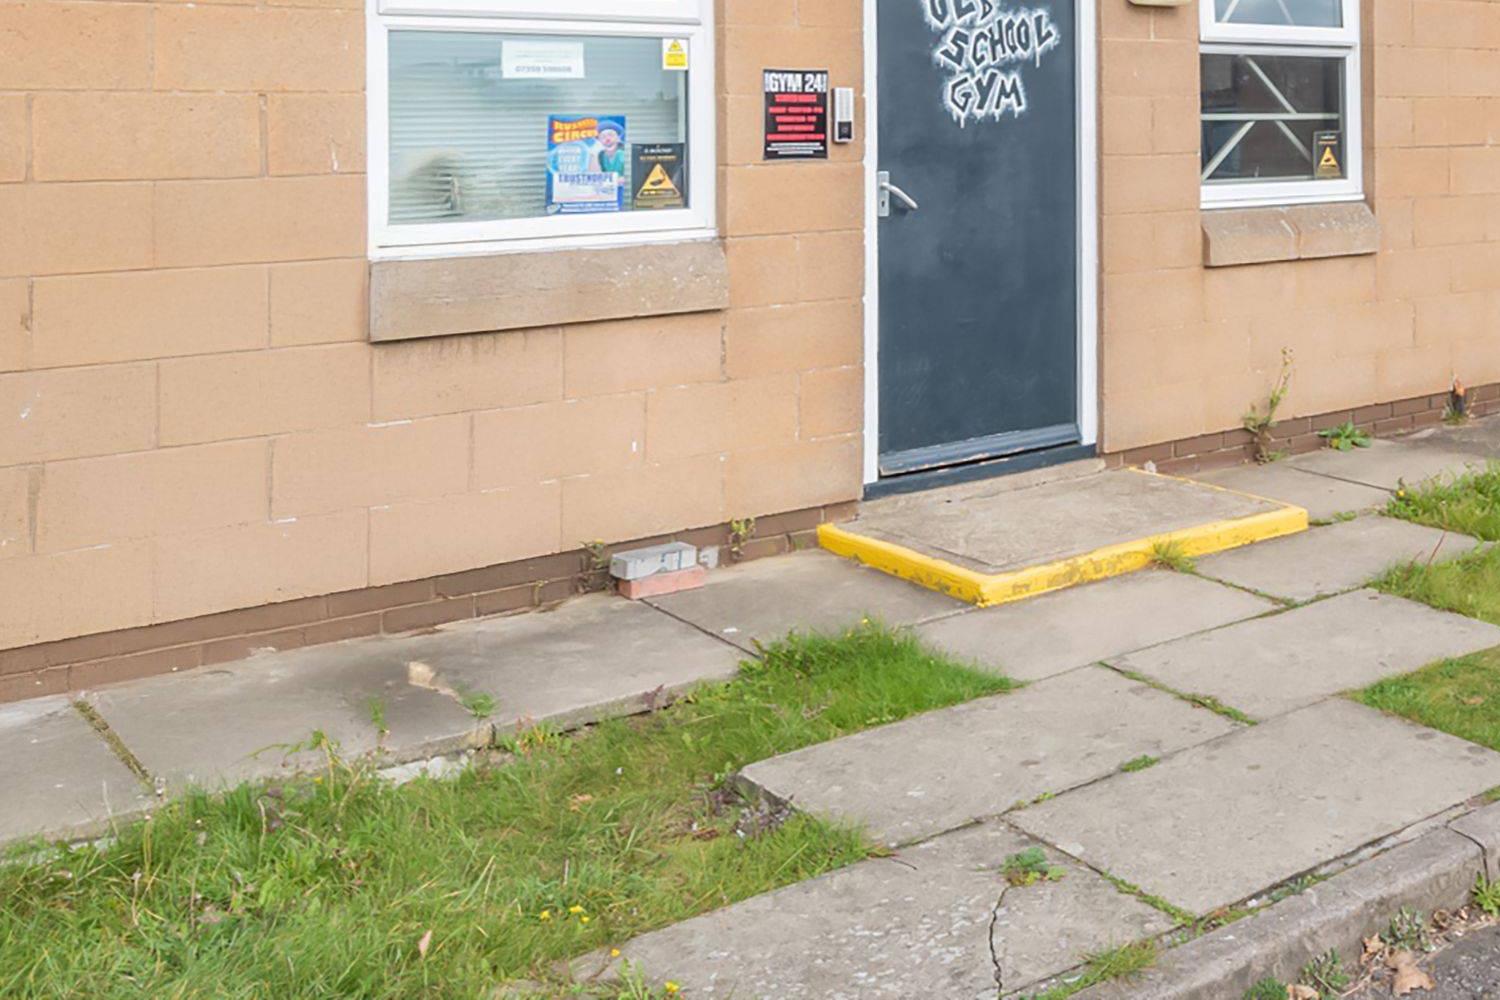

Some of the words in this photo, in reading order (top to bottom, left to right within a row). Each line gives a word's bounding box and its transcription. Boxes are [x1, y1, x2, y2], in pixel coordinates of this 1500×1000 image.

[936, 11, 1056, 69] SCHOOL
[769, 72, 803, 92] GYM
[804, 73, 822, 93] 24
[948, 68, 1026, 115] GYM
